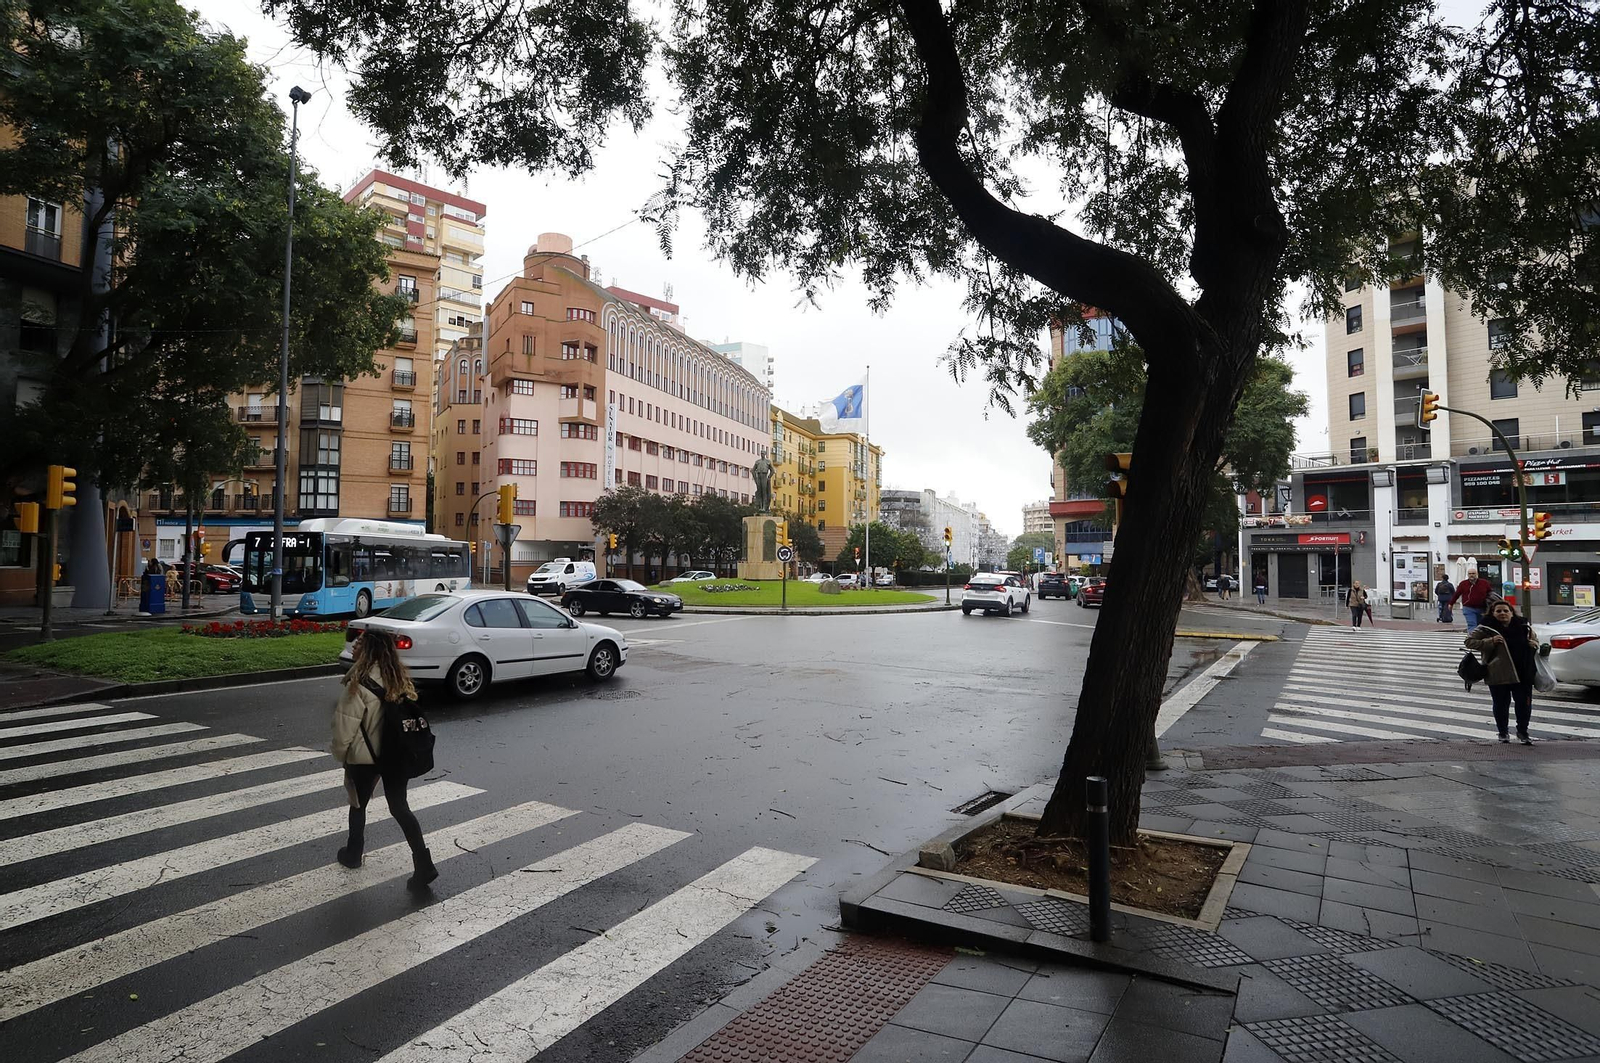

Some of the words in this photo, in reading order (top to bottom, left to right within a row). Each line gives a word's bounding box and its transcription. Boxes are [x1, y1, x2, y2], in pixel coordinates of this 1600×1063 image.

[1546, 458, 1562, 466] Hut
[1551, 528, 1573, 536] arket
[254, 537, 261, 548] 7
[270, 537, 297, 548] ZFRA
[1035, 549, 1042, 557] P
